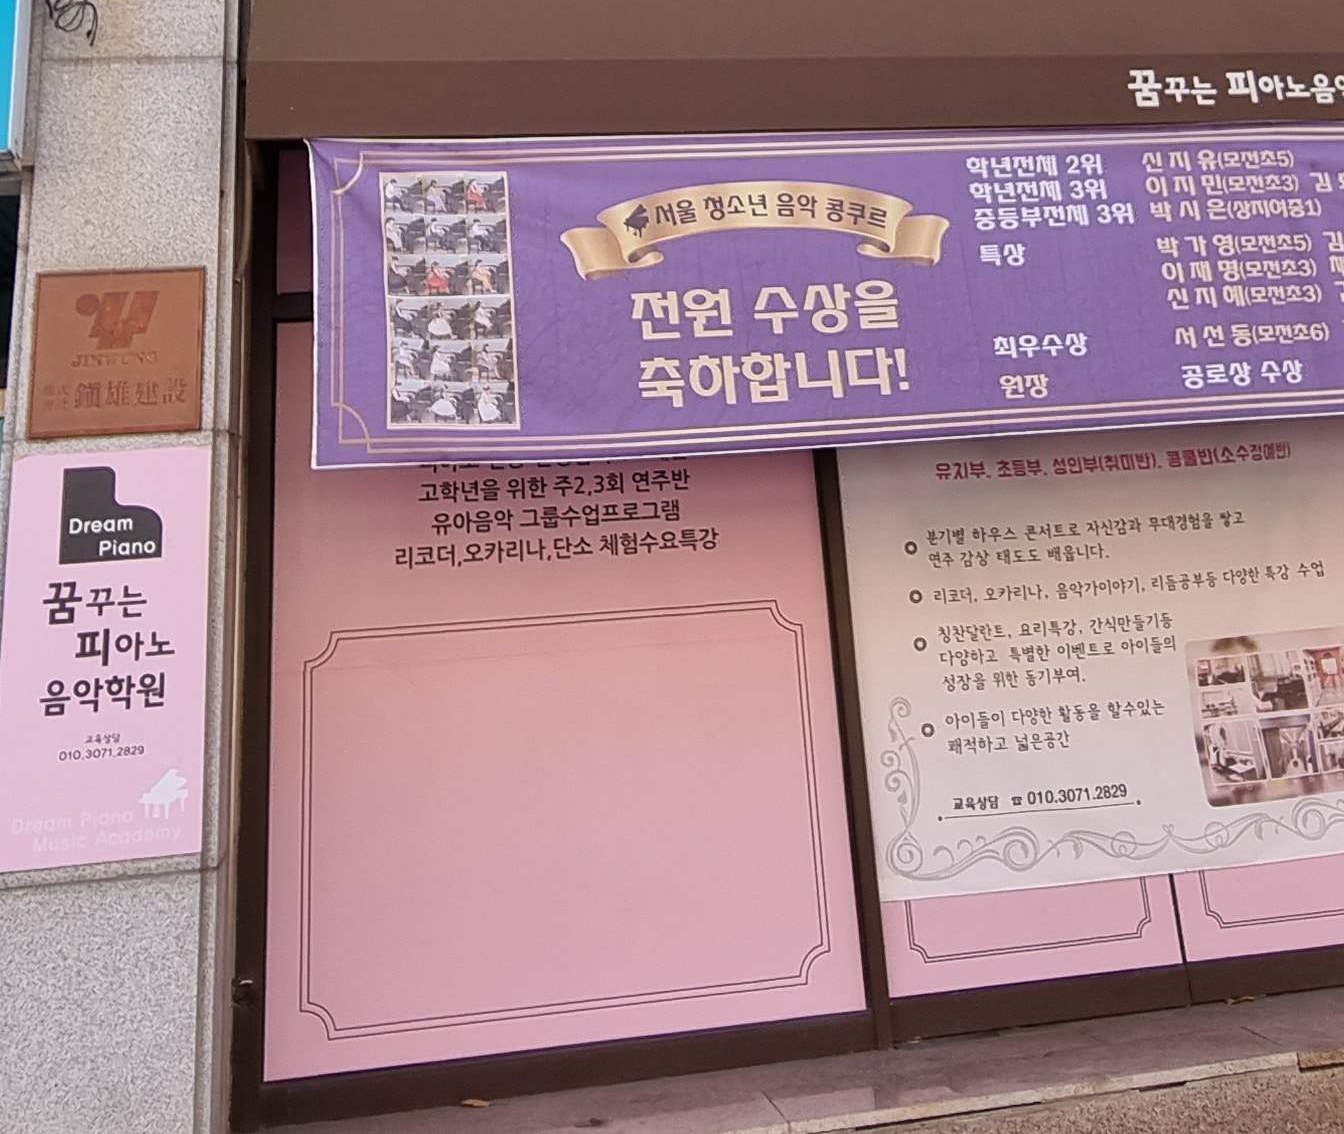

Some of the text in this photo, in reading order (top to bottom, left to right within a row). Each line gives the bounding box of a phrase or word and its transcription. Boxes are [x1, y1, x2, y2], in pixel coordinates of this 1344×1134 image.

[1127, 68, 1217, 107] 꿈꾸는
[966, 154, 1058, 179] 학년전체
[1065, 154, 1104, 176] 2위
[969, 179, 1108, 204] 학년전체 3위
[655, 193, 888, 229] 서울 청소년 음악 콩쿠르
[973, 202, 1135, 231] 중등부전체 3위
[979, 243, 1026, 266] 특상
[630, 280, 899, 341] 전원 수상을
[992, 332, 1088, 358] 최우수상
[638, 346, 910, 408] 축하합니다!
[999, 360, 1304, 399] 원장 공로상 수상
[418, 468, 691, 504] 고학년을 위한 주2,3회 연주반
[68, 515, 134, 535] Dream
[431, 499, 681, 536] 유아음악 그룹수업프로그램
[972, 526, 1018, 542] 하우스
[1024, 523, 1082, 541] 콘서트로
[1086, 517, 1142, 537] 자신감과
[99, 538, 156, 556] Piano
[395, 527, 720, 570] 리코더,오카리나,단소 체험수요특강
[928, 550, 955, 569] 연주
[959, 549, 990, 568] 감상
[1222, 566, 1260, 586] 다양한
[1297, 560, 1326, 578] 수업
[42, 581, 148, 625] 꿈꾸는
[75, 628, 175, 666] 피아노
[939, 635, 1177, 667] 다양하고 특별한 이벤트로 아이들의
[39, 671, 166, 717] 음악학원
[942, 673, 986, 693] 성장을
[992, 670, 1018, 688] 위한
[945, 710, 1006, 730] 아이들이
[1011, 707, 1053, 726] 다양한
[1058, 702, 1102, 724] 활동을
[58, 745, 145, 761] 010.3071.2829
[952, 783, 1129, 811] 교육상담 010.3071.2829
